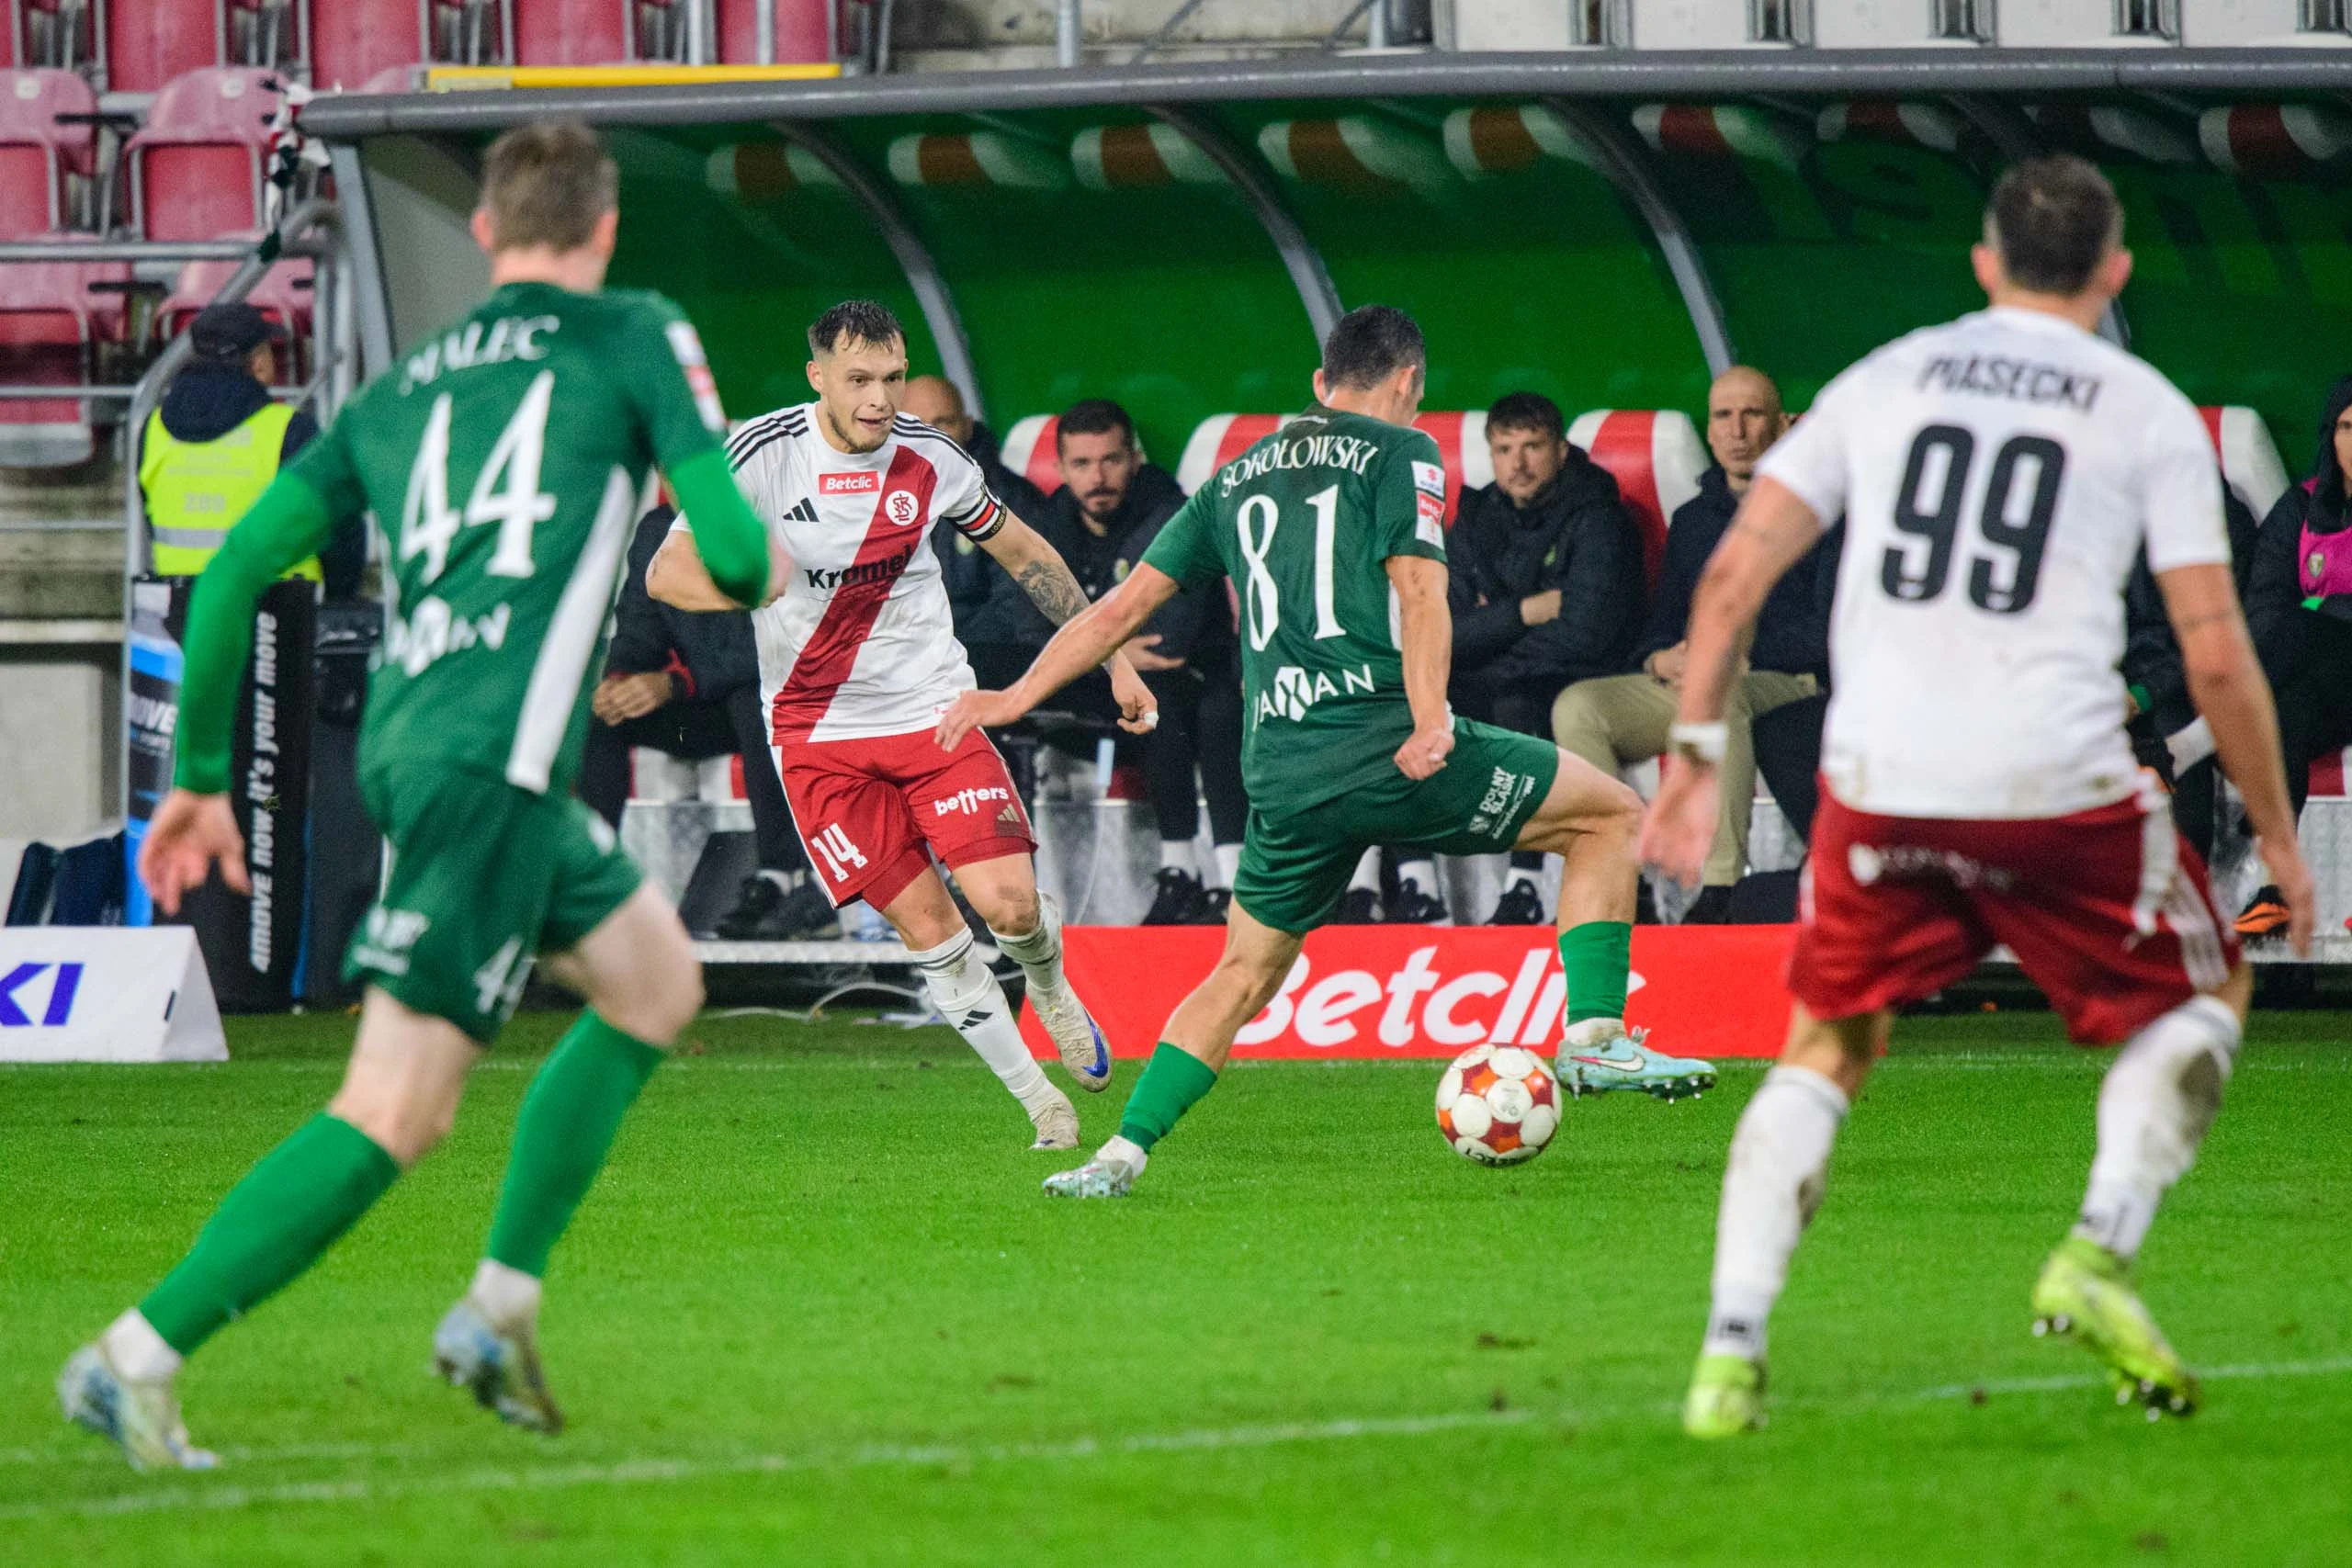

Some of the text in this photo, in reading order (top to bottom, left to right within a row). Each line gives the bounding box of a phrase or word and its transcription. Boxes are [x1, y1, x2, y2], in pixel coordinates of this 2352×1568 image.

[399, 369, 557, 586] 44
[825, 475, 873, 491] Betclic
[1881, 423, 2066, 614] 99
[1236, 484, 1347, 652] 81
[254, 611, 277, 686] move
[254, 688, 279, 756] your
[933, 786, 1010, 817] betters
[252, 806, 274, 867] now
[810, 822, 869, 883] 14
